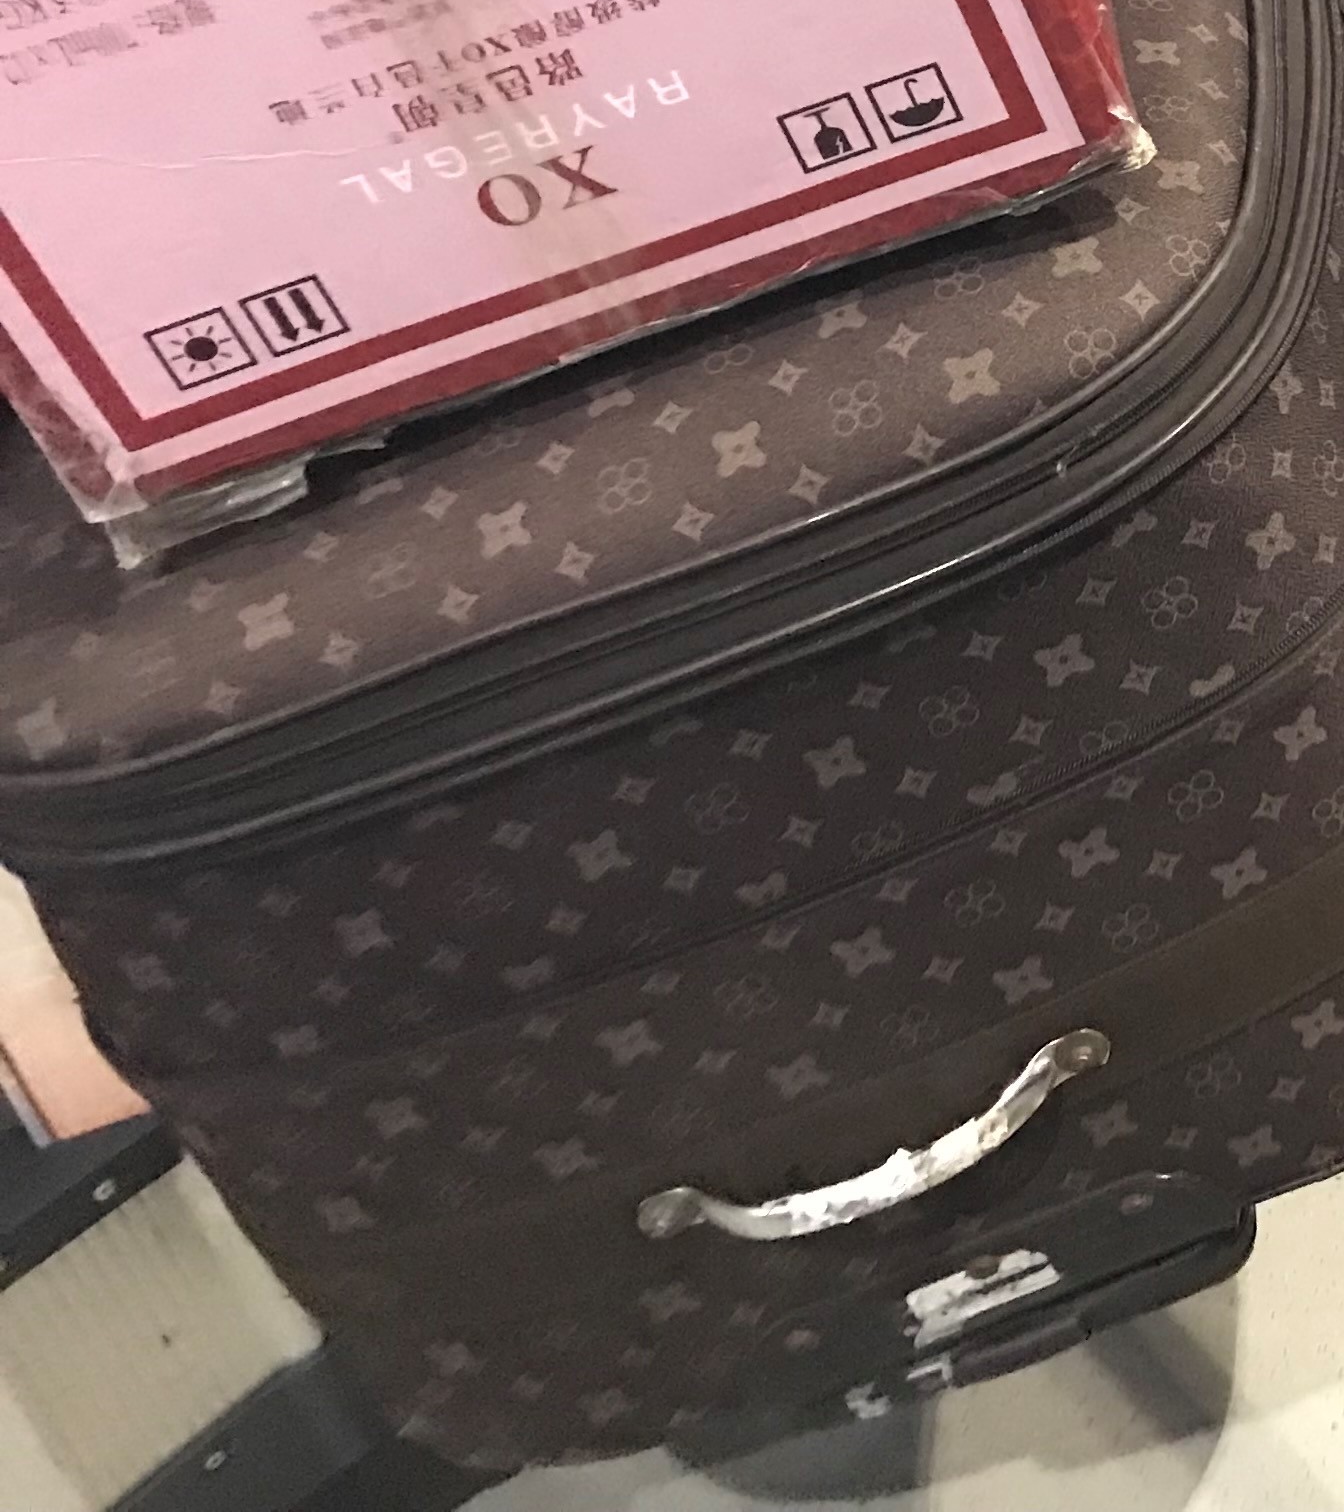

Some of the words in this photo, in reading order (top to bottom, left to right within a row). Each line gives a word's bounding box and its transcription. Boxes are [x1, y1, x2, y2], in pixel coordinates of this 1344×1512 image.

[389, 47, 584, 135] 路邑皇朝
[337, 68, 691, 210] RAYREGAL
[467, 143, 620, 234] XO
